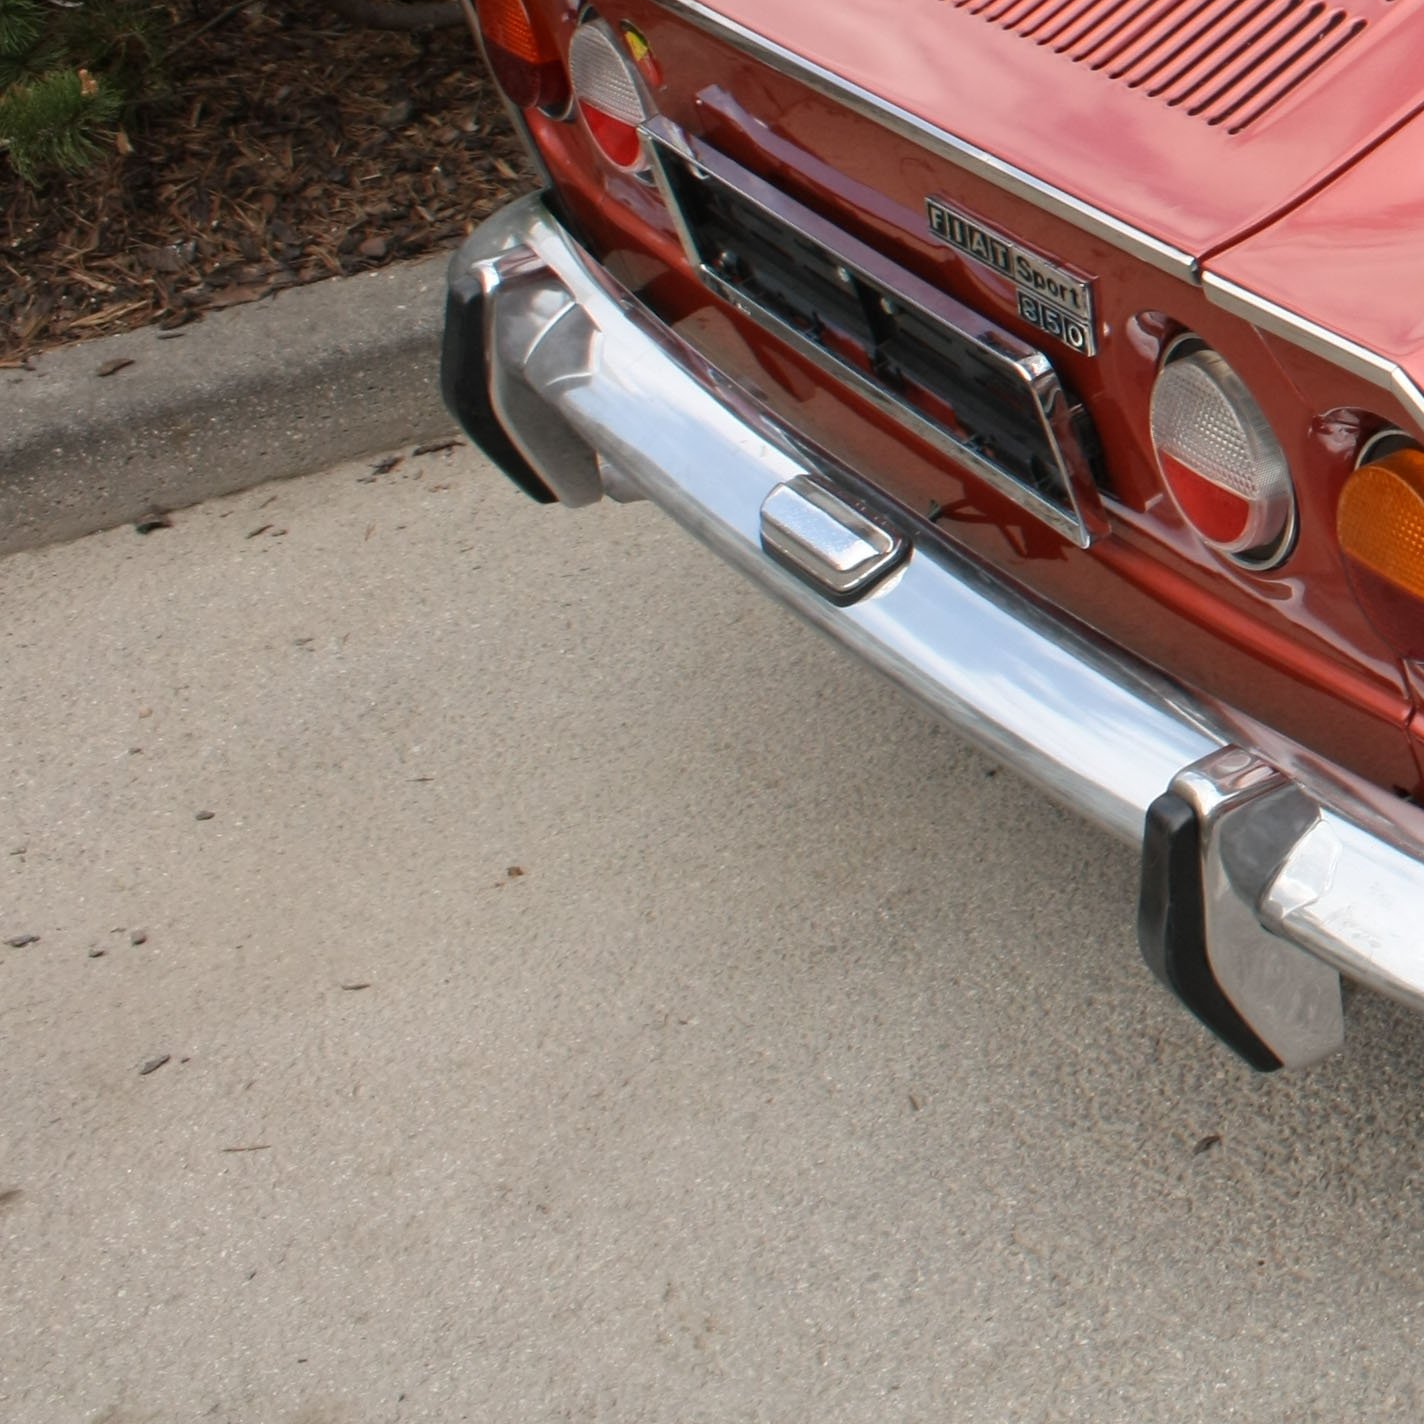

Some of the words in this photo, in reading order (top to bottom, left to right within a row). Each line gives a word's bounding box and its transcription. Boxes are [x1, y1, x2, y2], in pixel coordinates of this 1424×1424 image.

[929, 206, 1010, 269] FIAT
[1015, 255, 1081, 309] Sport
[1019, 295, 1087, 348] 850
